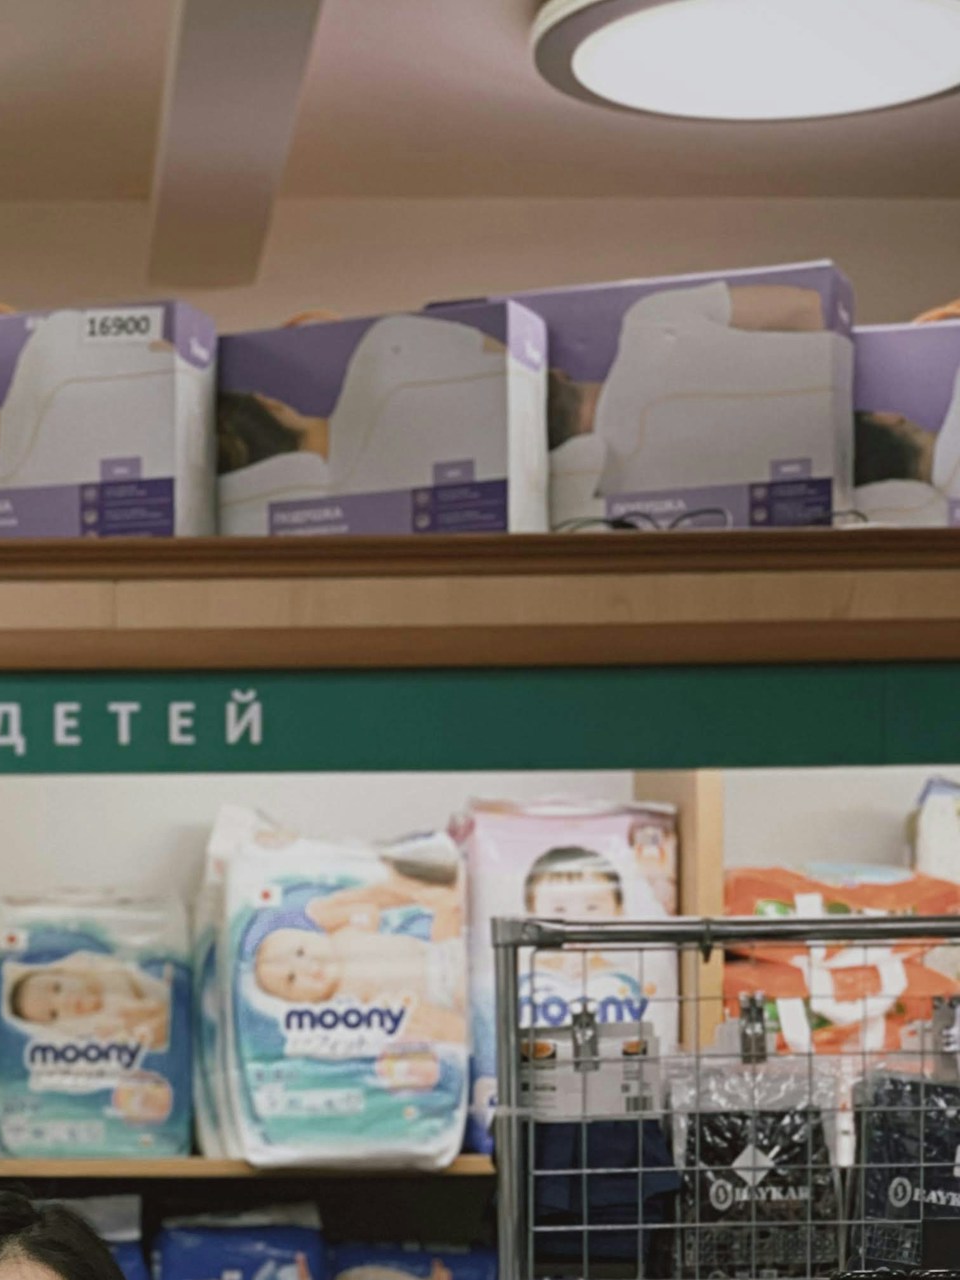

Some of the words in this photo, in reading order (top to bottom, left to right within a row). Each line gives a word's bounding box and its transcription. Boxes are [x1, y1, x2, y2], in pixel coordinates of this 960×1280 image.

[87, 315, 149, 337] 16900
[285, 1006, 406, 1036] moony
[29, 1042, 141, 1068] moony
